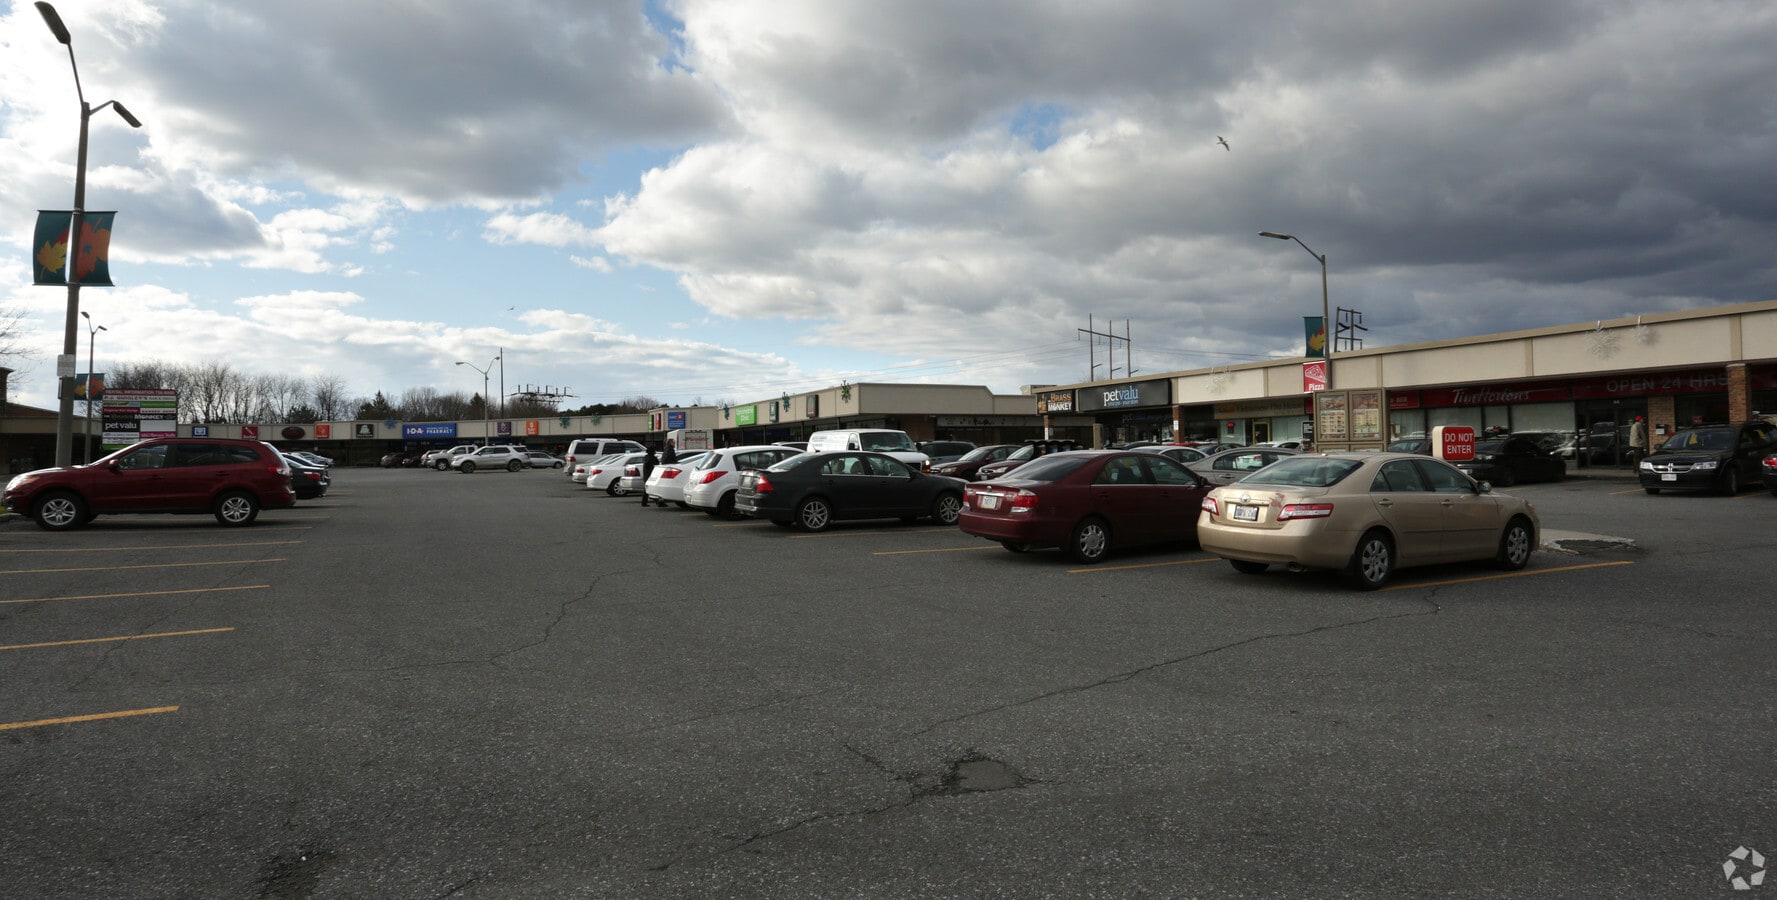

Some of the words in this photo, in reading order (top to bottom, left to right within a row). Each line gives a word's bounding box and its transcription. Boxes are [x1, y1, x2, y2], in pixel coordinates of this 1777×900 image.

[1607, 378, 1655, 392] OPEN
[1661, 377, 1681, 389] 24
[1689, 374, 1729, 388] HRS
[1048, 402, 1073, 411] MONKEY
[105, 422, 119, 430] pet
[120, 421, 137, 429] valu
[1444, 432, 1456, 442] DO
[1458, 432, 1474, 442] NOT
[1447, 444, 1472, 454] ENTER
